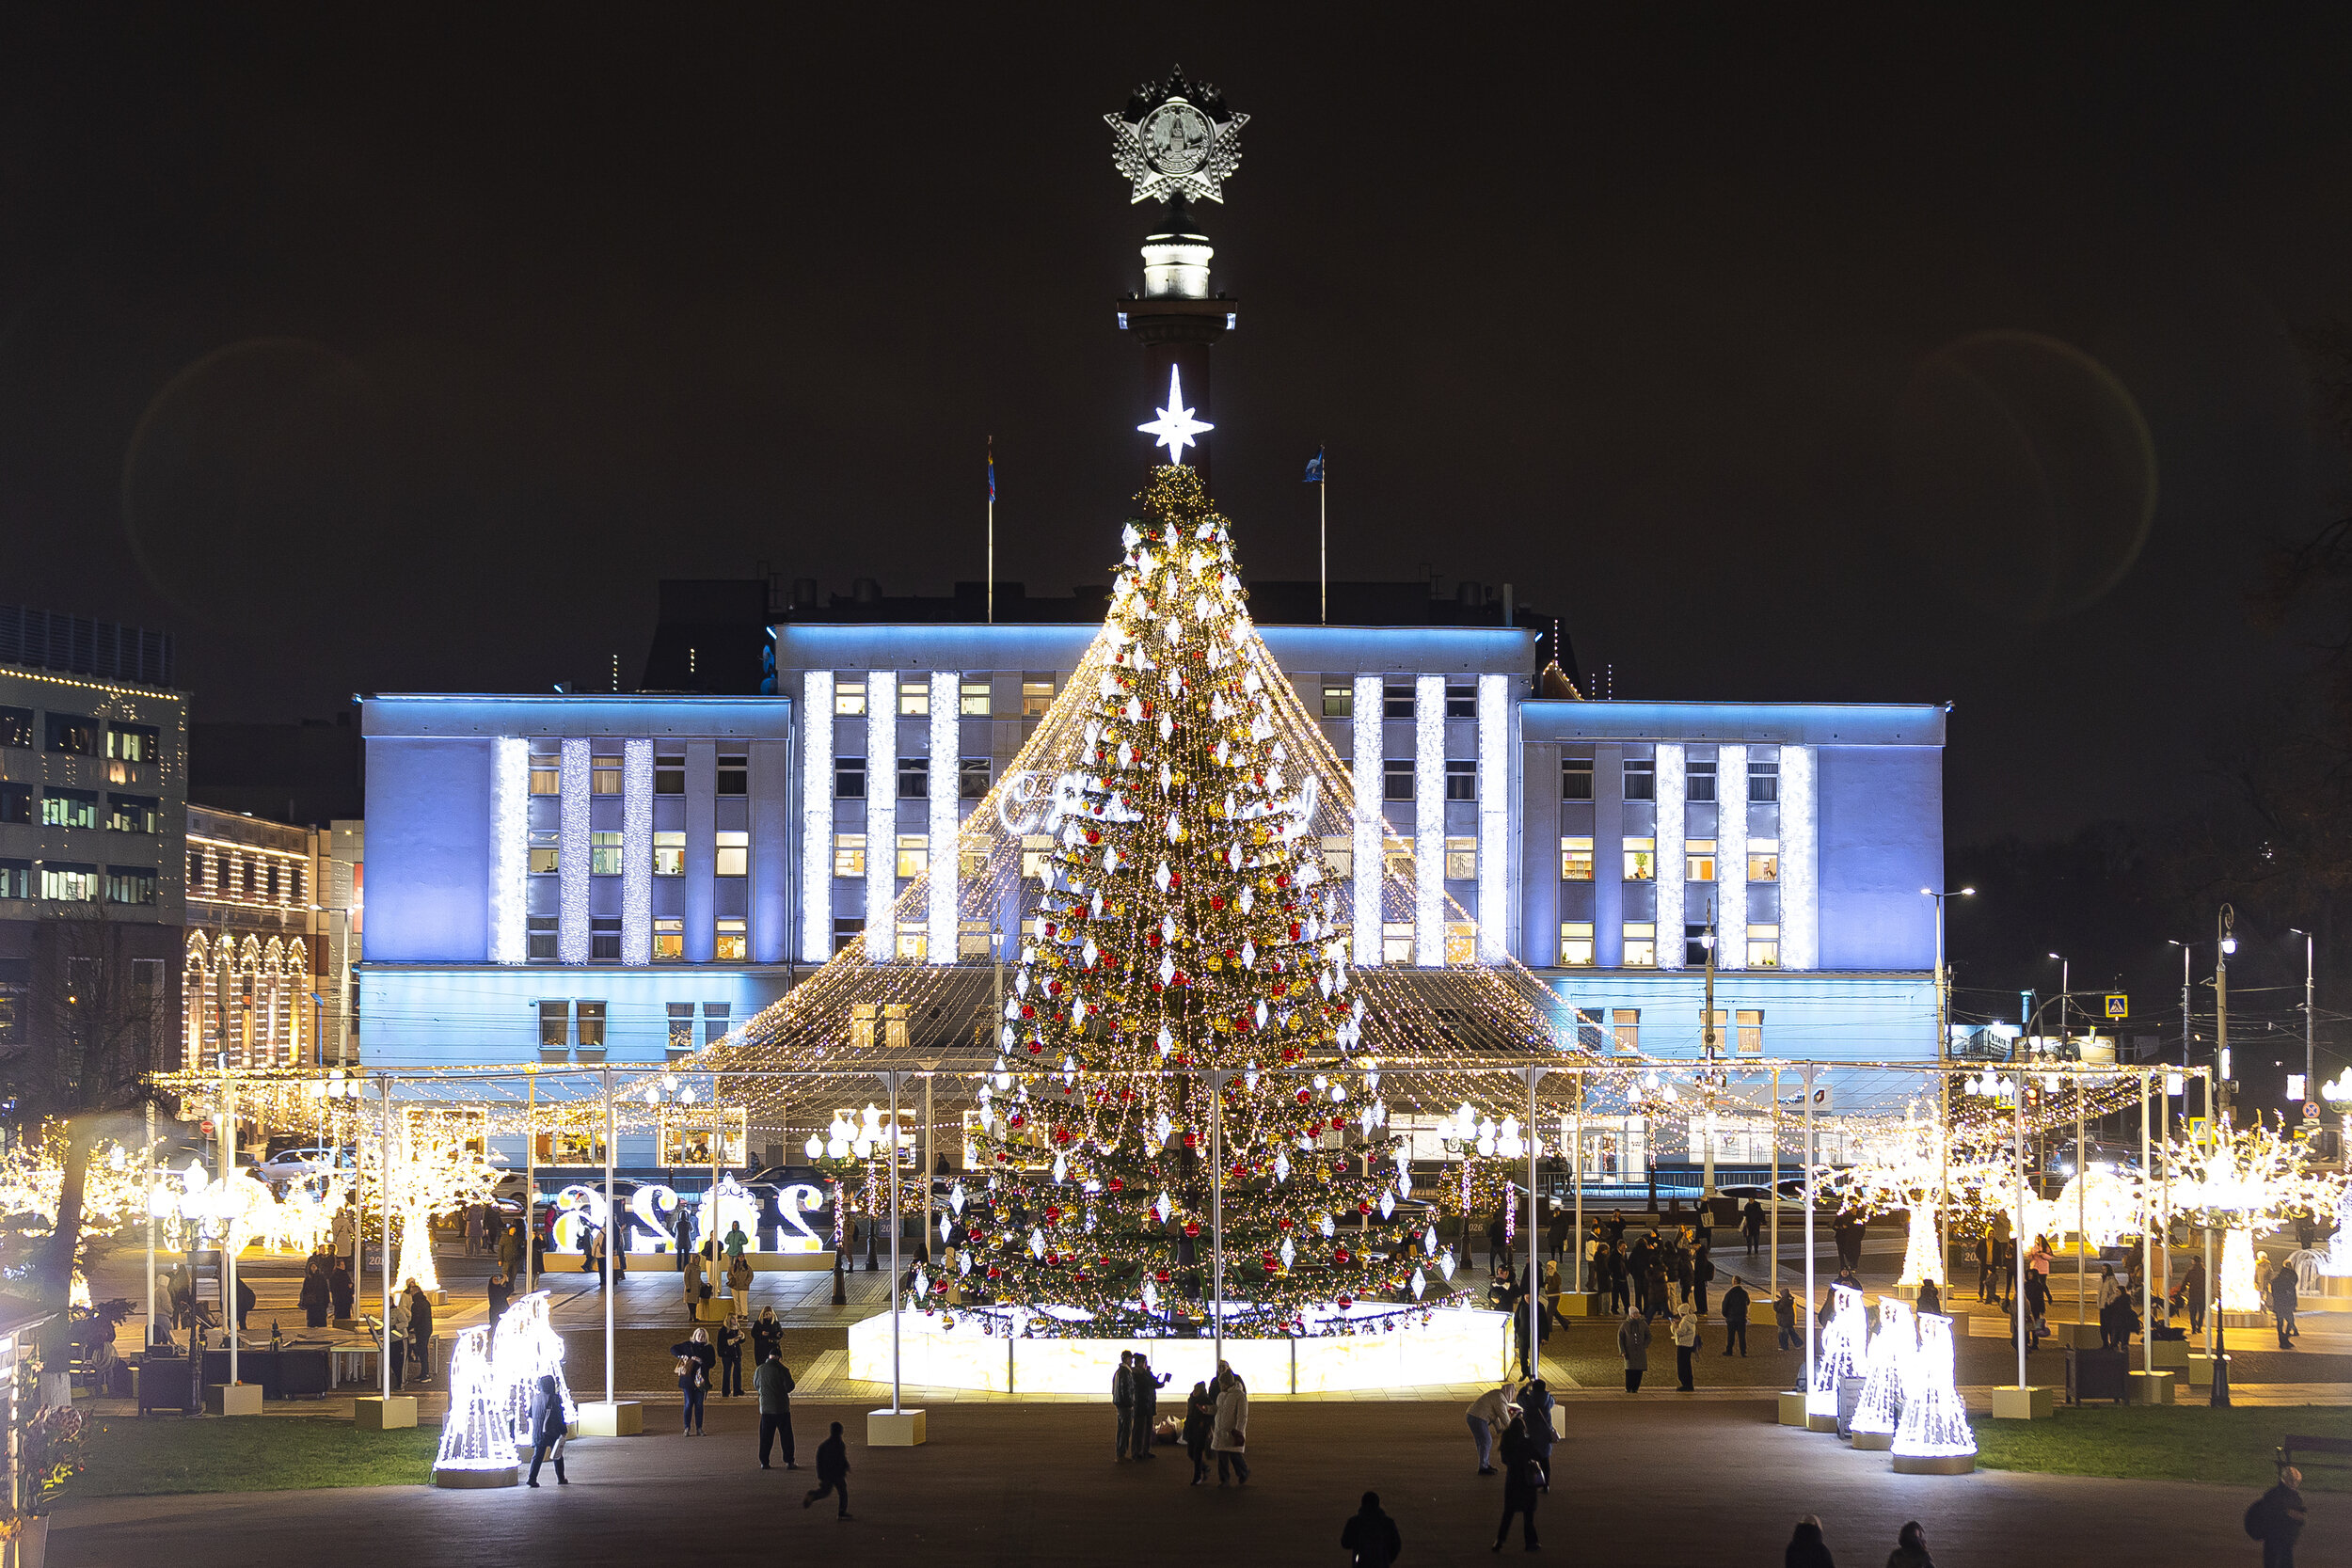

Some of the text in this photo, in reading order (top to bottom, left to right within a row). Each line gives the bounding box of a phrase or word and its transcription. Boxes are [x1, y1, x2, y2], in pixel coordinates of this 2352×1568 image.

[1468, 1223, 1484, 1232] 026
[368, 1256, 383, 1266] 20
[1963, 1252, 1977, 1262] 20
